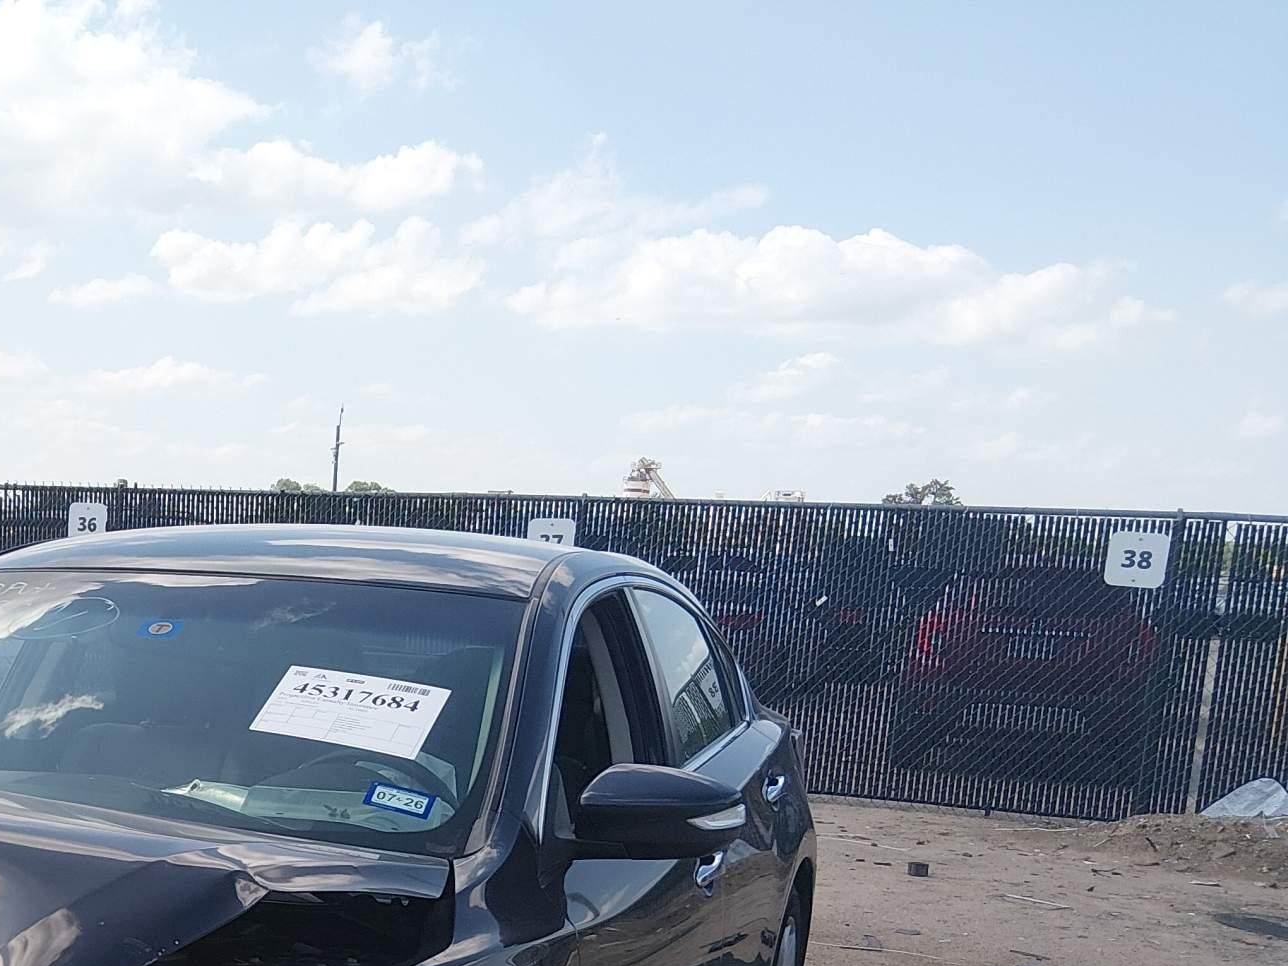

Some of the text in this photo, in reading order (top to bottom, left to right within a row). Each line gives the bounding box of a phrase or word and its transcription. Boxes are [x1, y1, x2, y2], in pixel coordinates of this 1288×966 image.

[77, 517, 97, 532] 36
[1120, 549, 1153, 570] 38
[293, 682, 421, 712] 45317684
